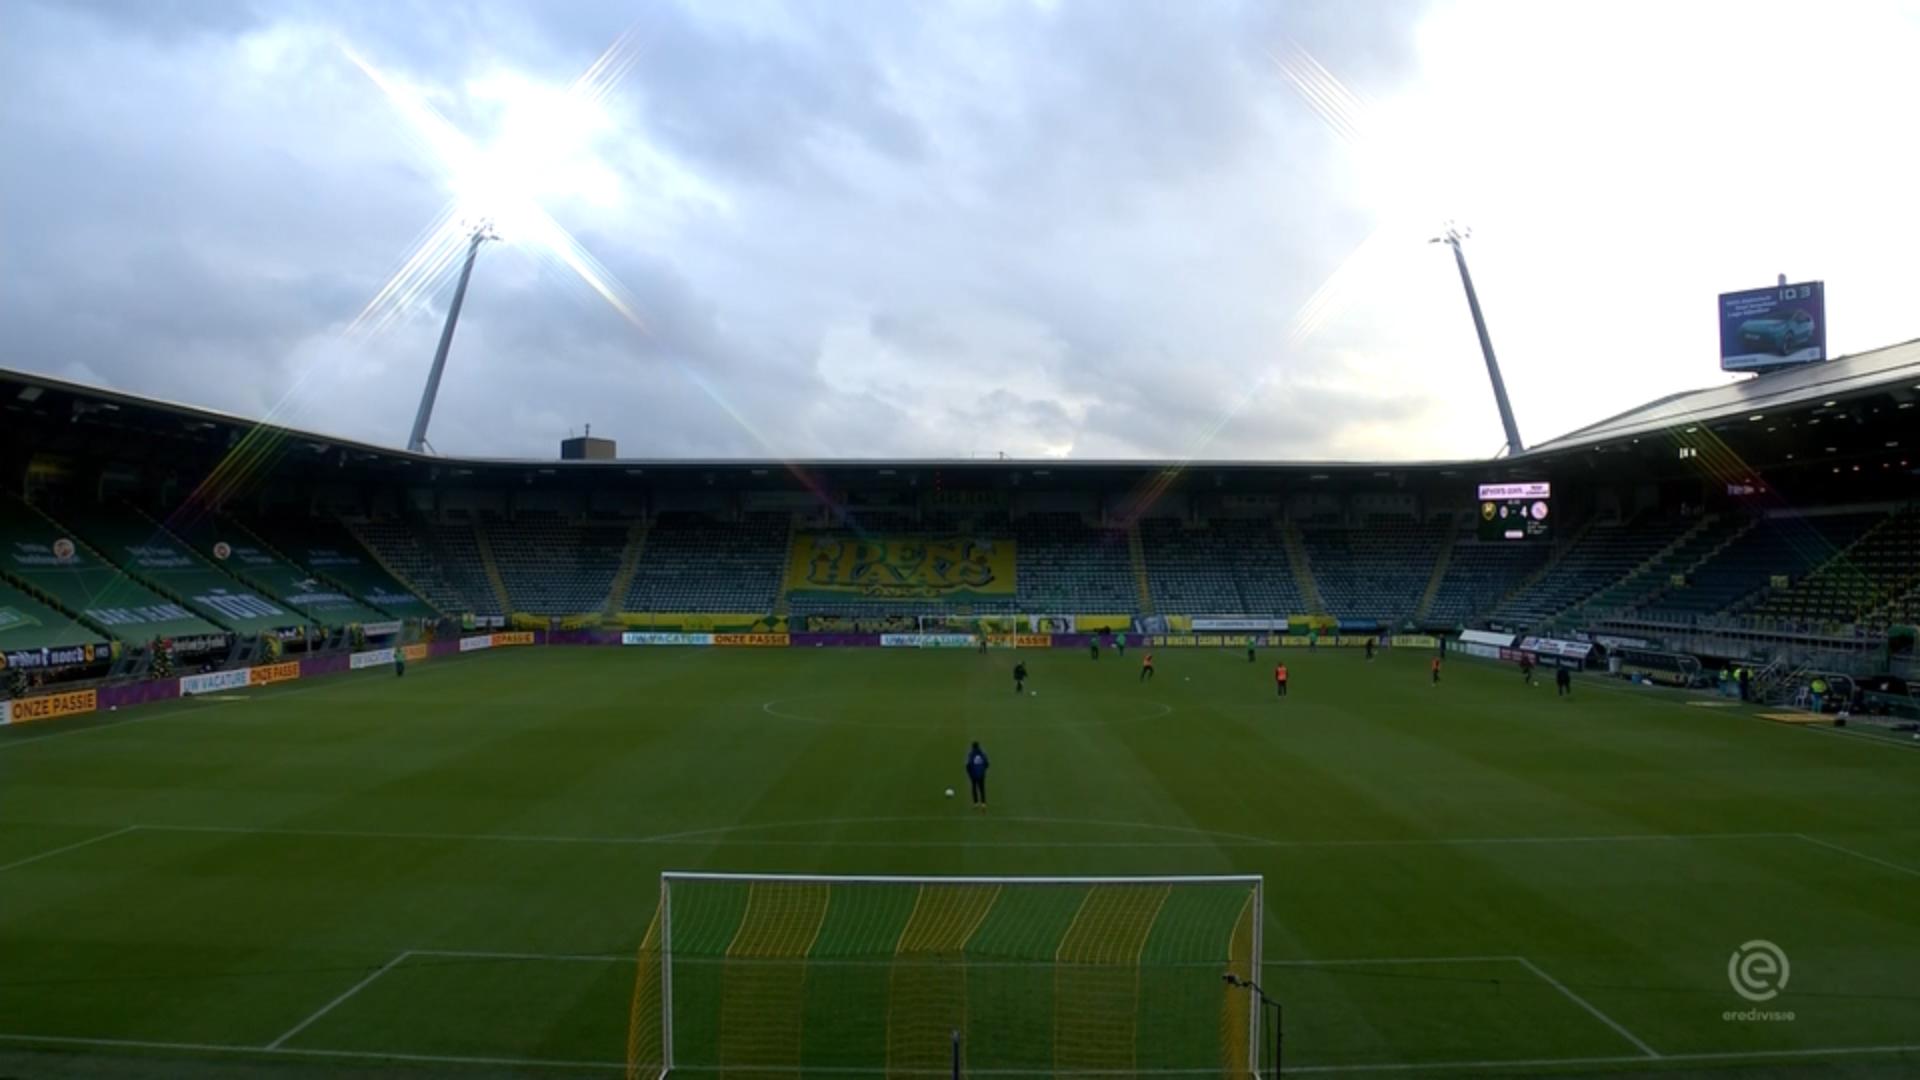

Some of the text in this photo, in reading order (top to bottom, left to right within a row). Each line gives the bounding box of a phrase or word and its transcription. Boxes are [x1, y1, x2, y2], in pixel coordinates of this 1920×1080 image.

[715, 634, 787, 643] ONZE PASSIE
[202, 671, 247, 689] VACATURE
[12, 699, 49, 719] ONZE
[52, 692, 94, 713] PASSIE
